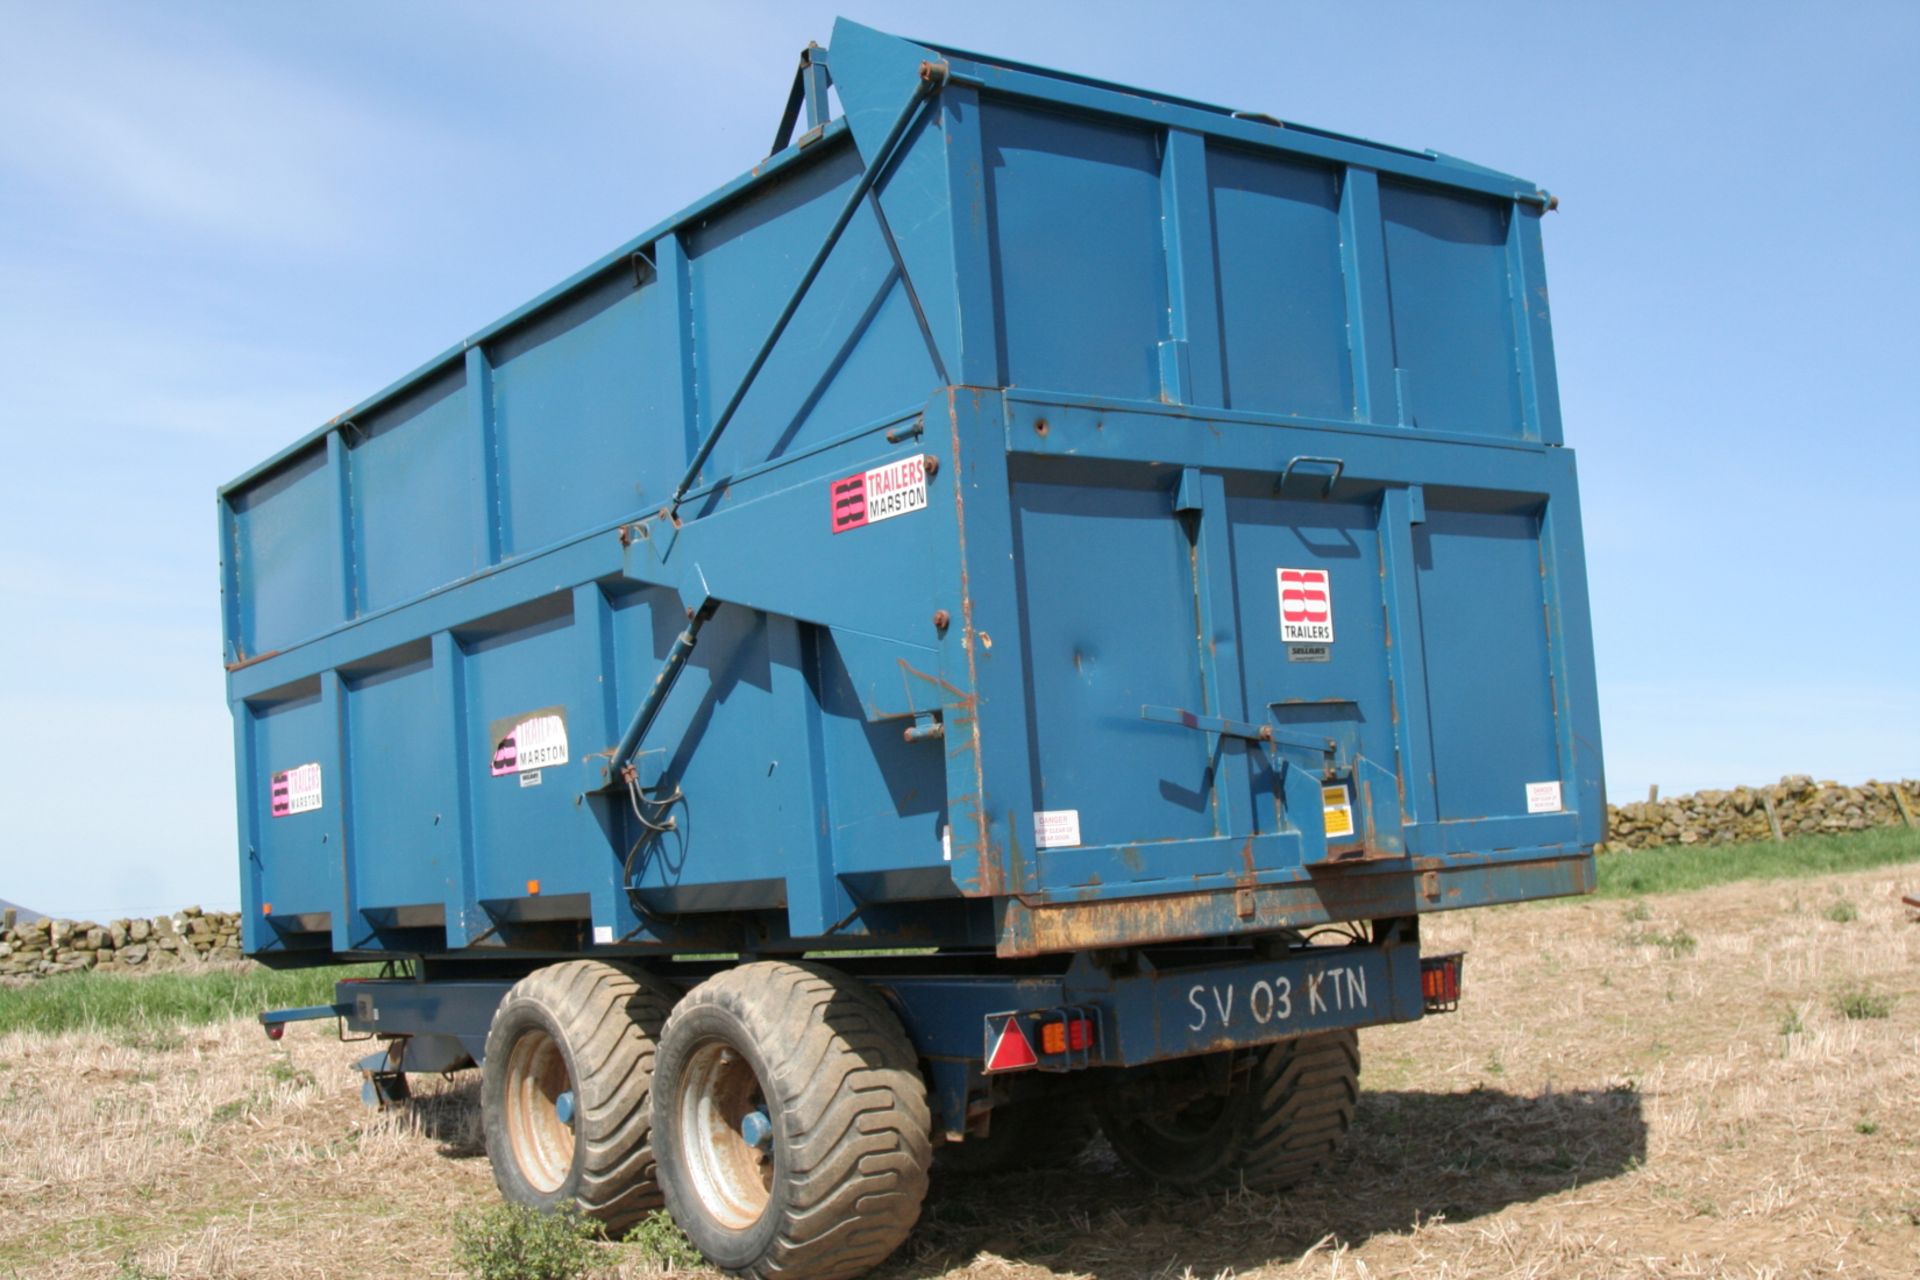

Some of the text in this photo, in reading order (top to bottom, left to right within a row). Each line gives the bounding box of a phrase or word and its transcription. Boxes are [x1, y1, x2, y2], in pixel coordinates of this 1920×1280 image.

[868, 460, 924, 497] TRAILERS
[870, 487, 925, 518] MARSTON
[1285, 625, 1330, 639] TRAILERS
[520, 745, 566, 765] MARSTON
[291, 794, 321, 809] MARSTON
[1039, 815, 1068, 824] DANGER
[1188, 965, 1367, 1031] SV 03 KTN
